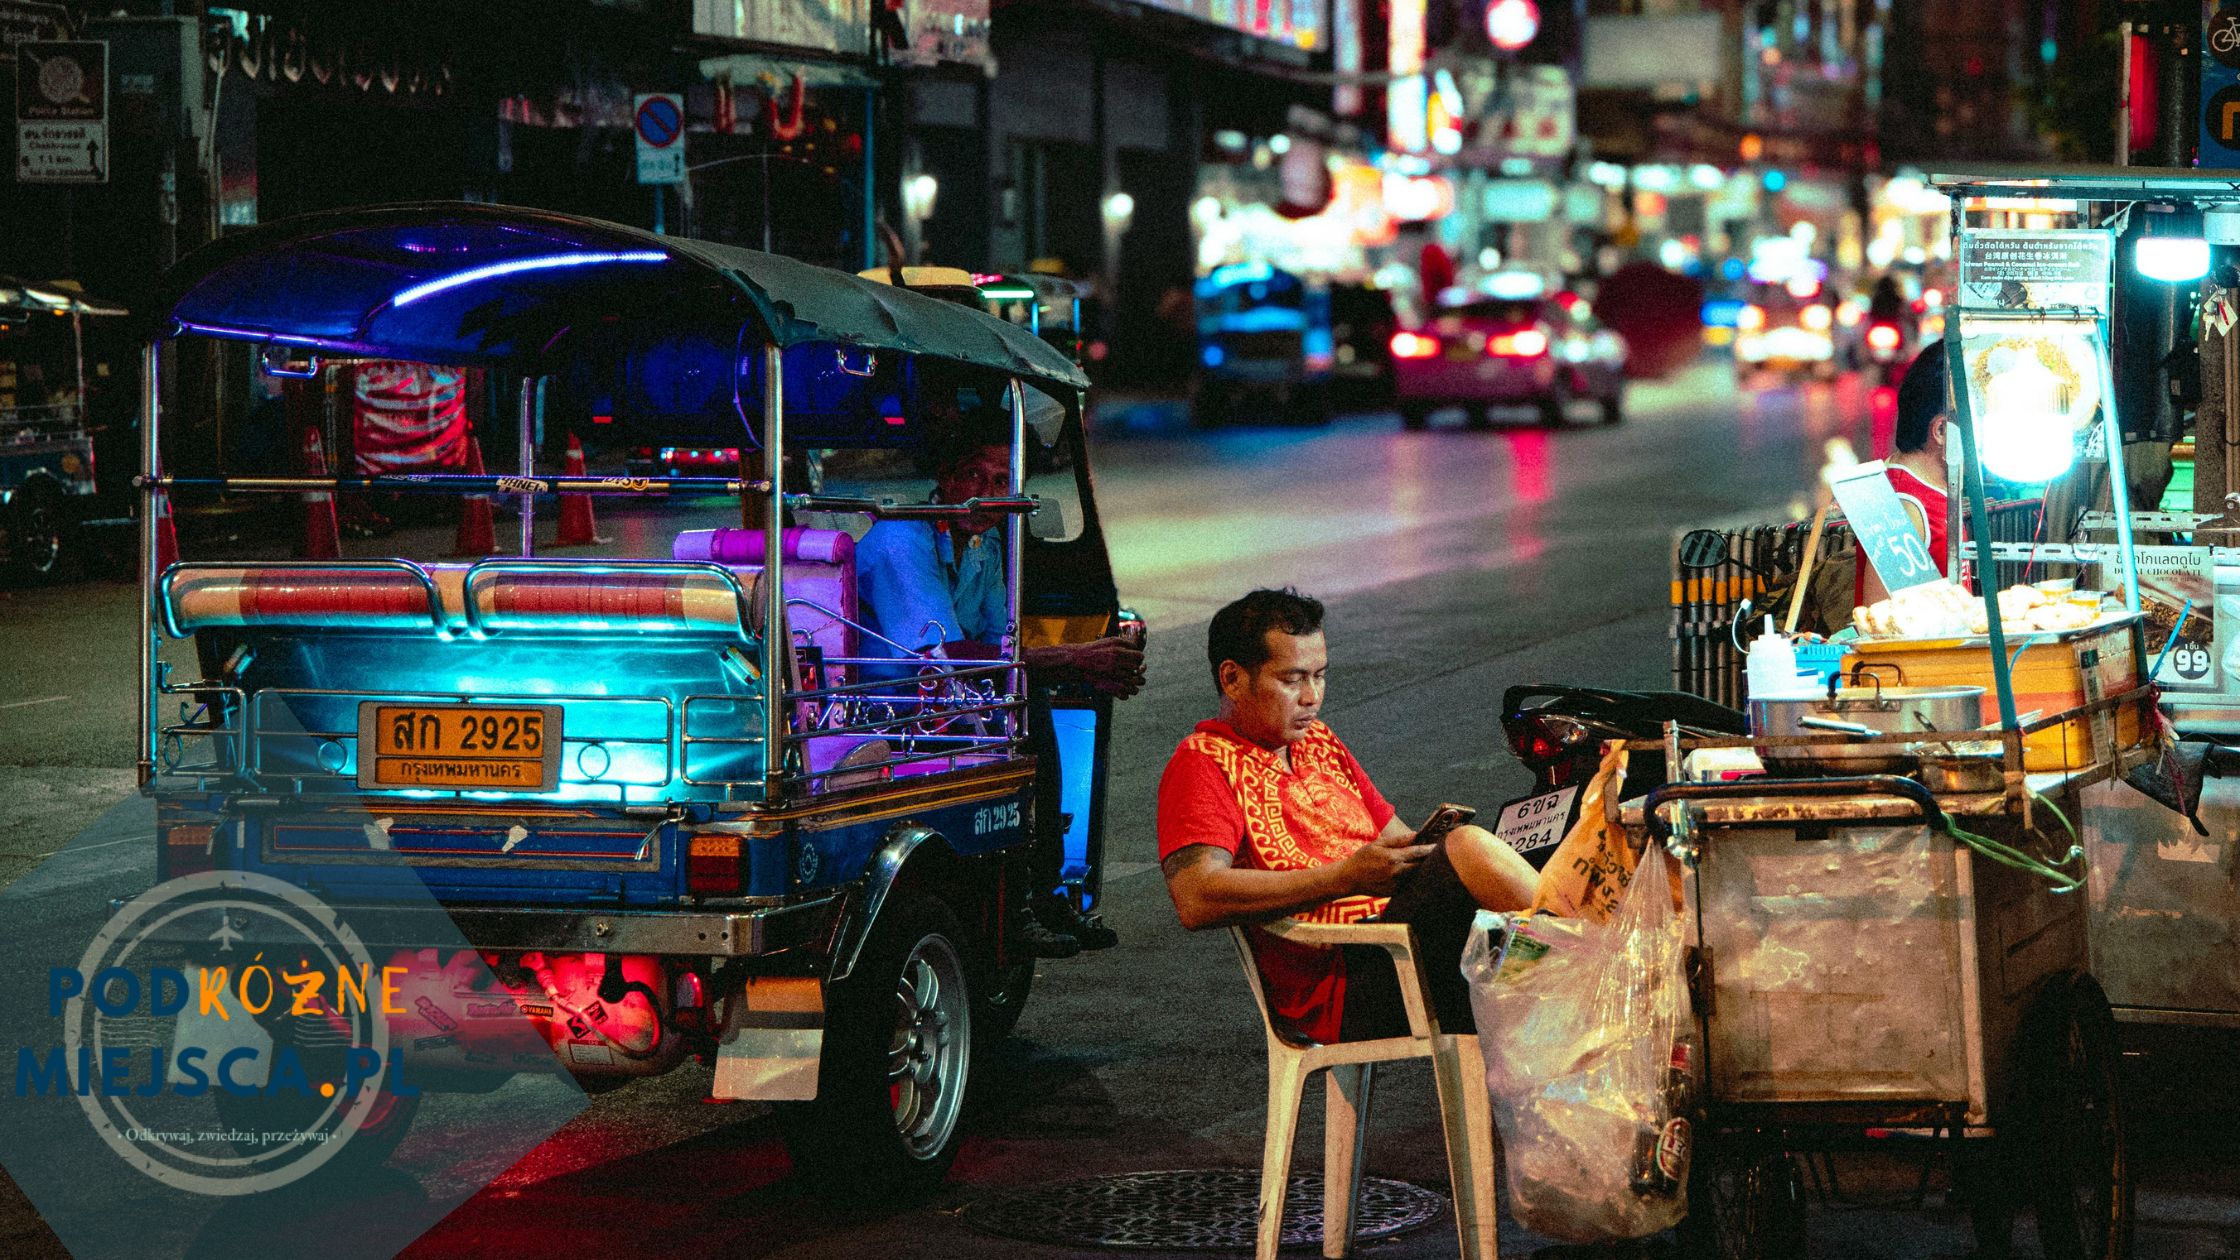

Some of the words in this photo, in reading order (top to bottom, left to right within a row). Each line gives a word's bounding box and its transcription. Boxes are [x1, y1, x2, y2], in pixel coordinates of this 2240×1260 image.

[394, 711, 441, 750] สก
[460, 715, 542, 750] 2925
[401, 761, 521, 782] กรุงเทพมหานคร
[993, 802, 1021, 830] 2925
[528, 1006, 552, 1016] YAMAHA
